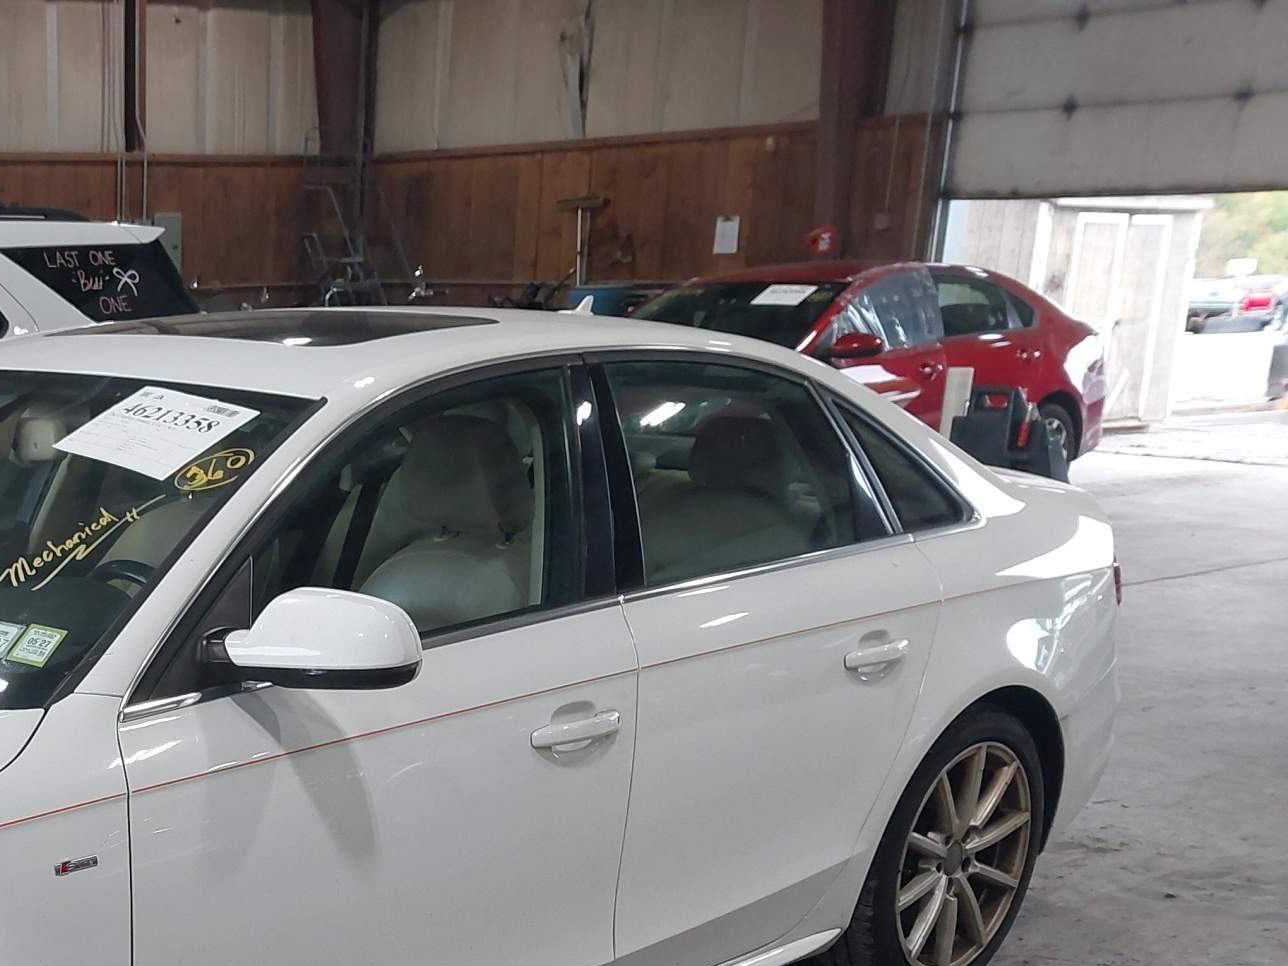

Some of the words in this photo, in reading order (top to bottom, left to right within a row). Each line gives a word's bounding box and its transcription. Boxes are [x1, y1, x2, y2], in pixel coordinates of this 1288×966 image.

[43, 251, 81, 268] LAST
[88, 250, 118, 266] ONE
[98, 296, 133, 315] ONE
[123, 403, 221, 434] 46213358
